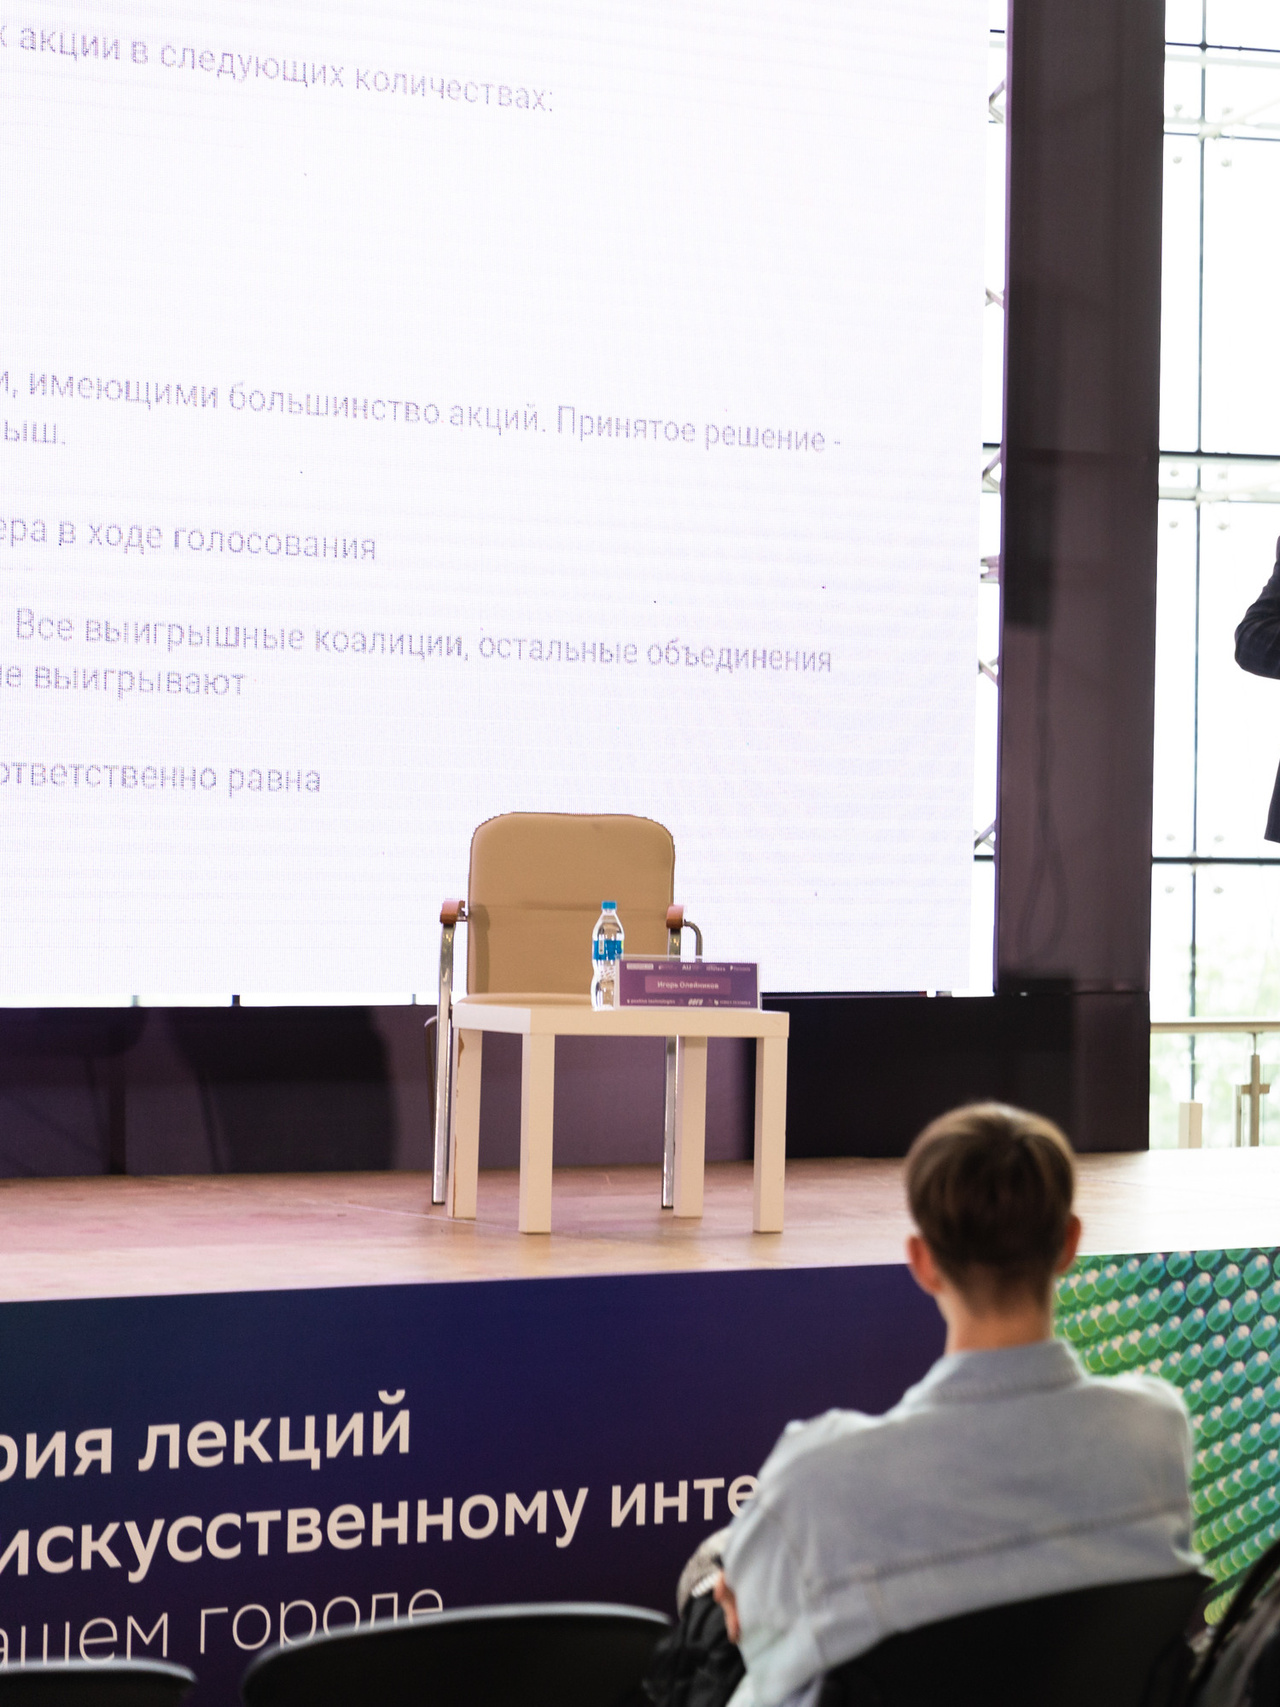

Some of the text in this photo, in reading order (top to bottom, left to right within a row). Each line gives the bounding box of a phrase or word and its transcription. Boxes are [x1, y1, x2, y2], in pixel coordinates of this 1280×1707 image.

[20, 27, 121, 61] акции
[131, 40, 149, 65] в
[160, 43, 345, 89] следующих
[355, 68, 553, 112] количествах:
[30, 372, 219, 411] имеющими
[229, 382, 440, 425] большинство
[449, 403, 546, 436] акций.
[557, 405, 696, 442] Принятое
[705, 420, 826, 452] решение
[58, 520, 77, 546] в
[89, 523, 163, 556] ходе
[174, 527, 376, 561] голосования
[16, 607, 832, 673] Все выигрышные коалиции, остальные объединения
[0, 664, 246, 701] е выигрывают
[228, 767, 321, 798] равна
[138, 1389, 409, 1471] лекций
[611, 1474, 759, 1528] инте
[0, 1612, 168, 1667] шем
